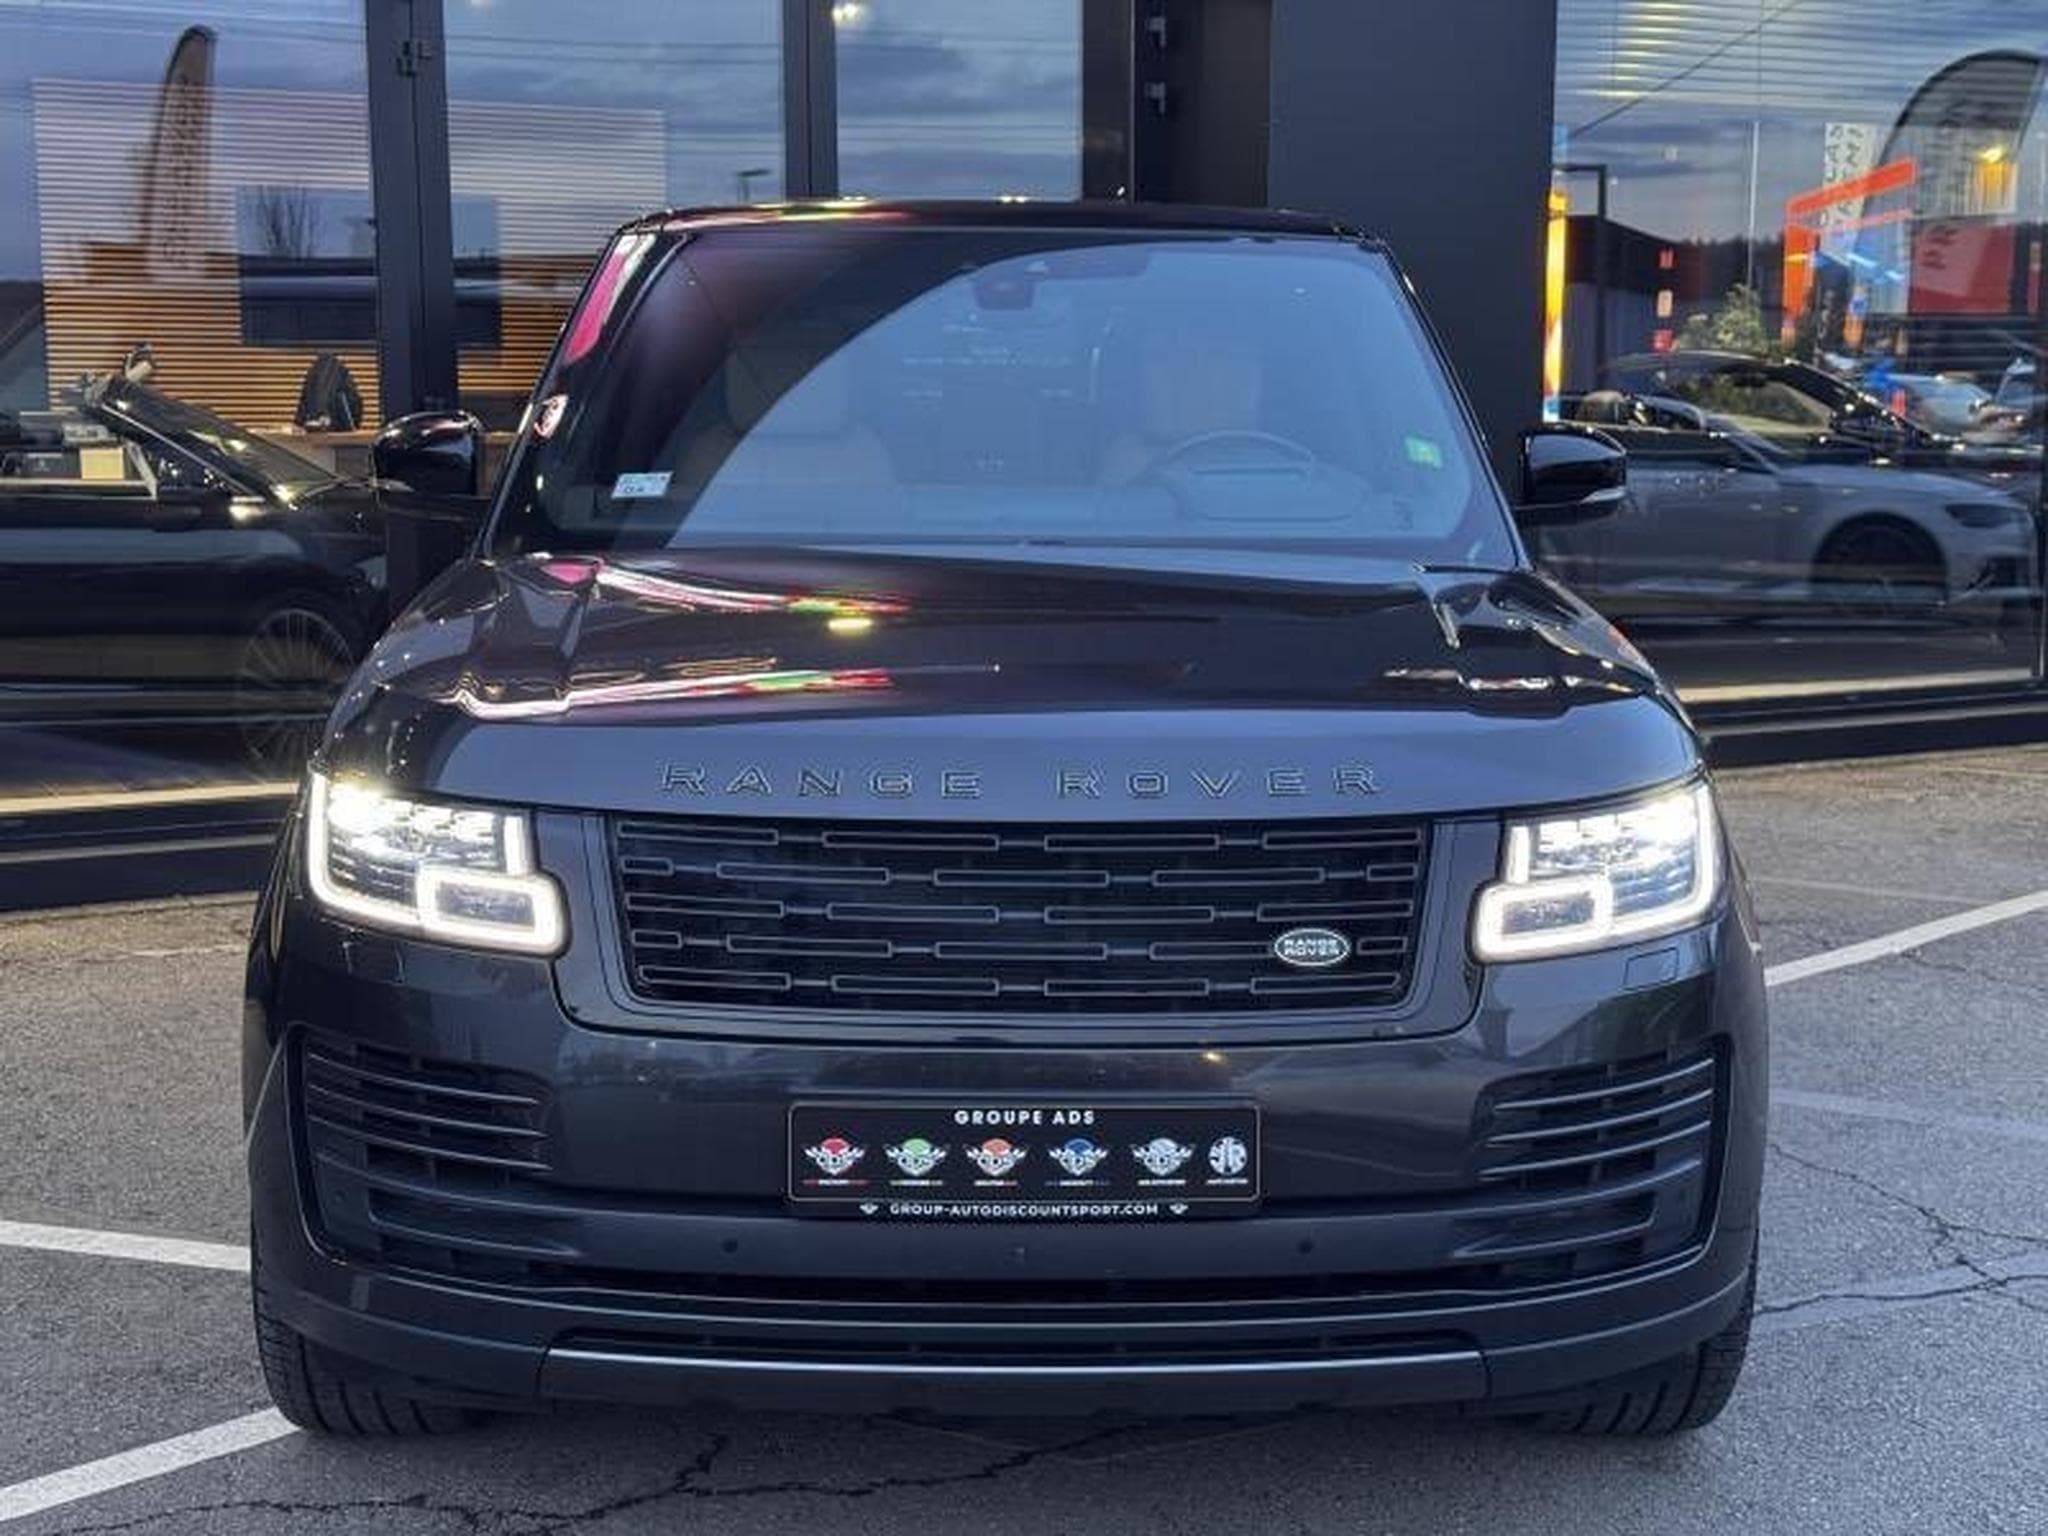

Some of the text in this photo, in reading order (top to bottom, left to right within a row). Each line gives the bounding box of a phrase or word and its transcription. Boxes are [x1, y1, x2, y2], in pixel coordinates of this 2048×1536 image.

[661, 763, 1382, 799] RANGE ROVER
[954, 1110, 1095, 1125] GROUPE ADS
[890, 1203, 1159, 1217] GROUP-AUTODISCOUNTSPORT.COM
